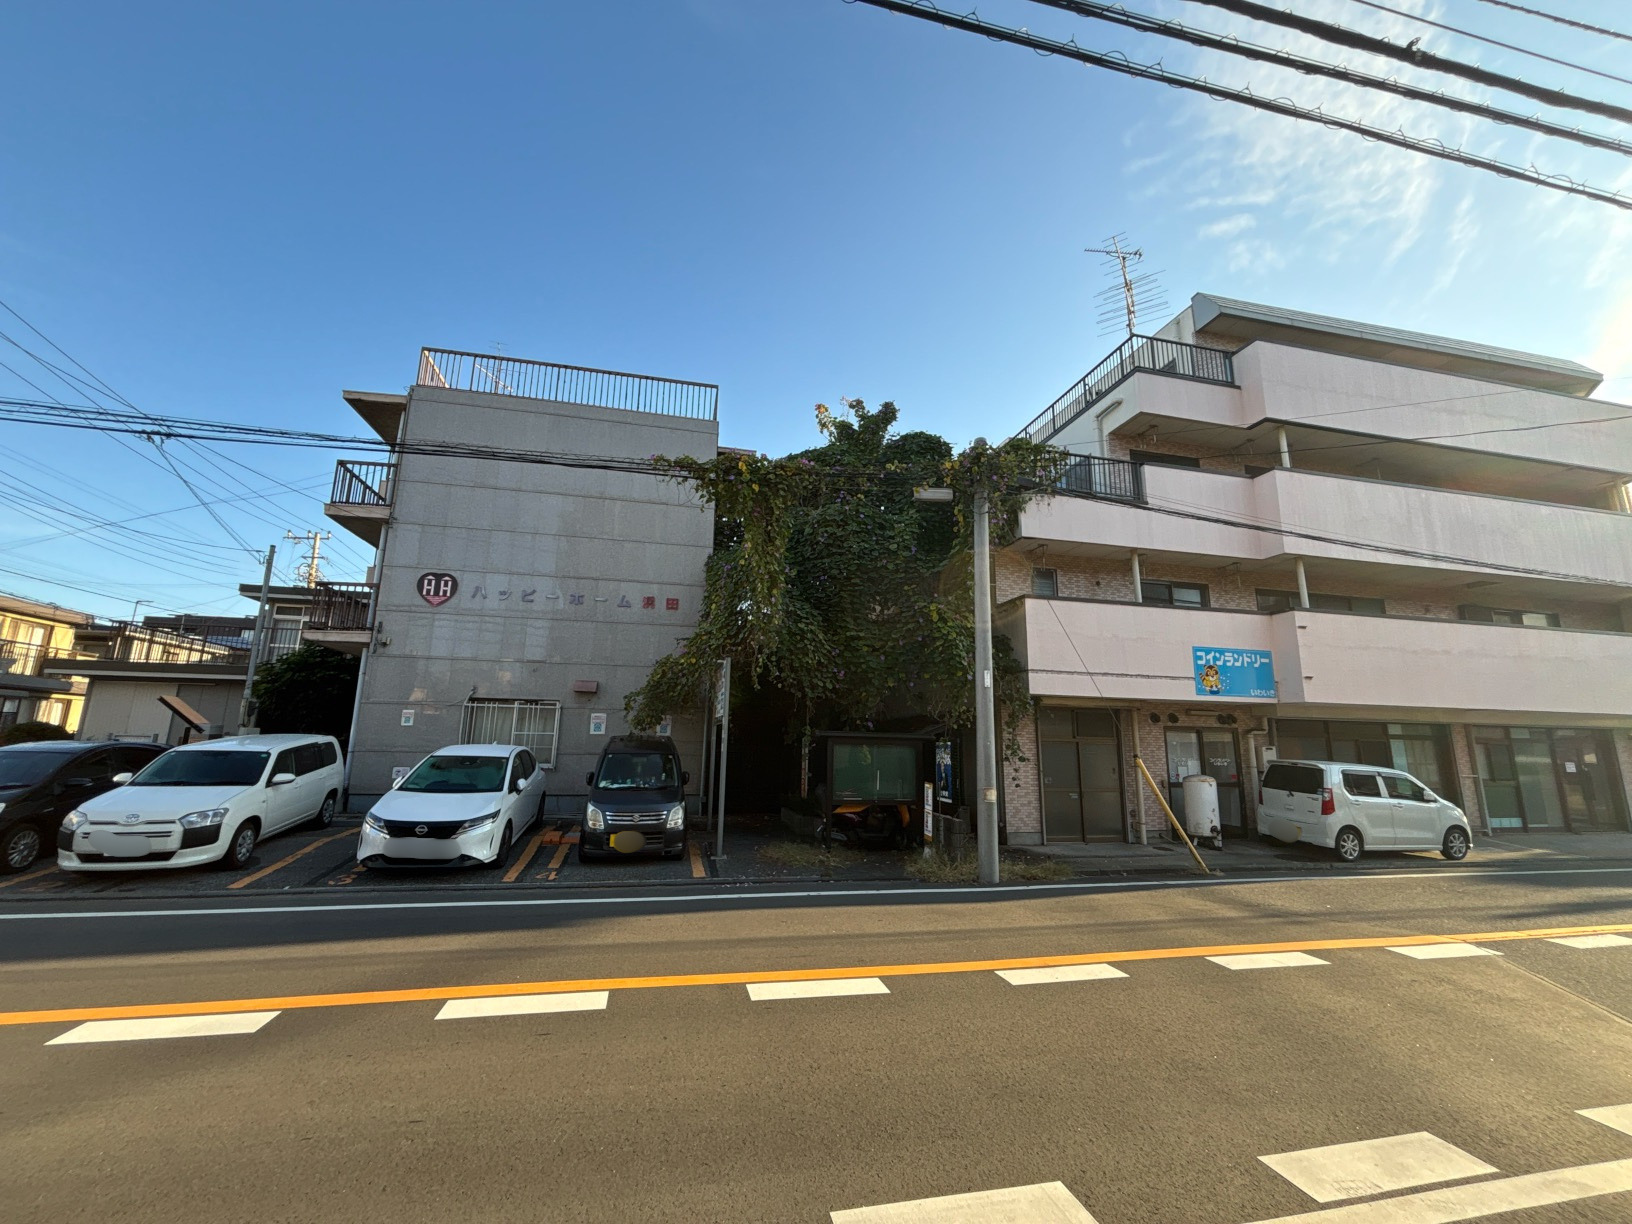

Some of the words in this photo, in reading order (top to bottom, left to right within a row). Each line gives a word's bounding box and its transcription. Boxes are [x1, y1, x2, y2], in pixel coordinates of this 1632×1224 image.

[1196, 651, 1270, 668] コインランドリー
